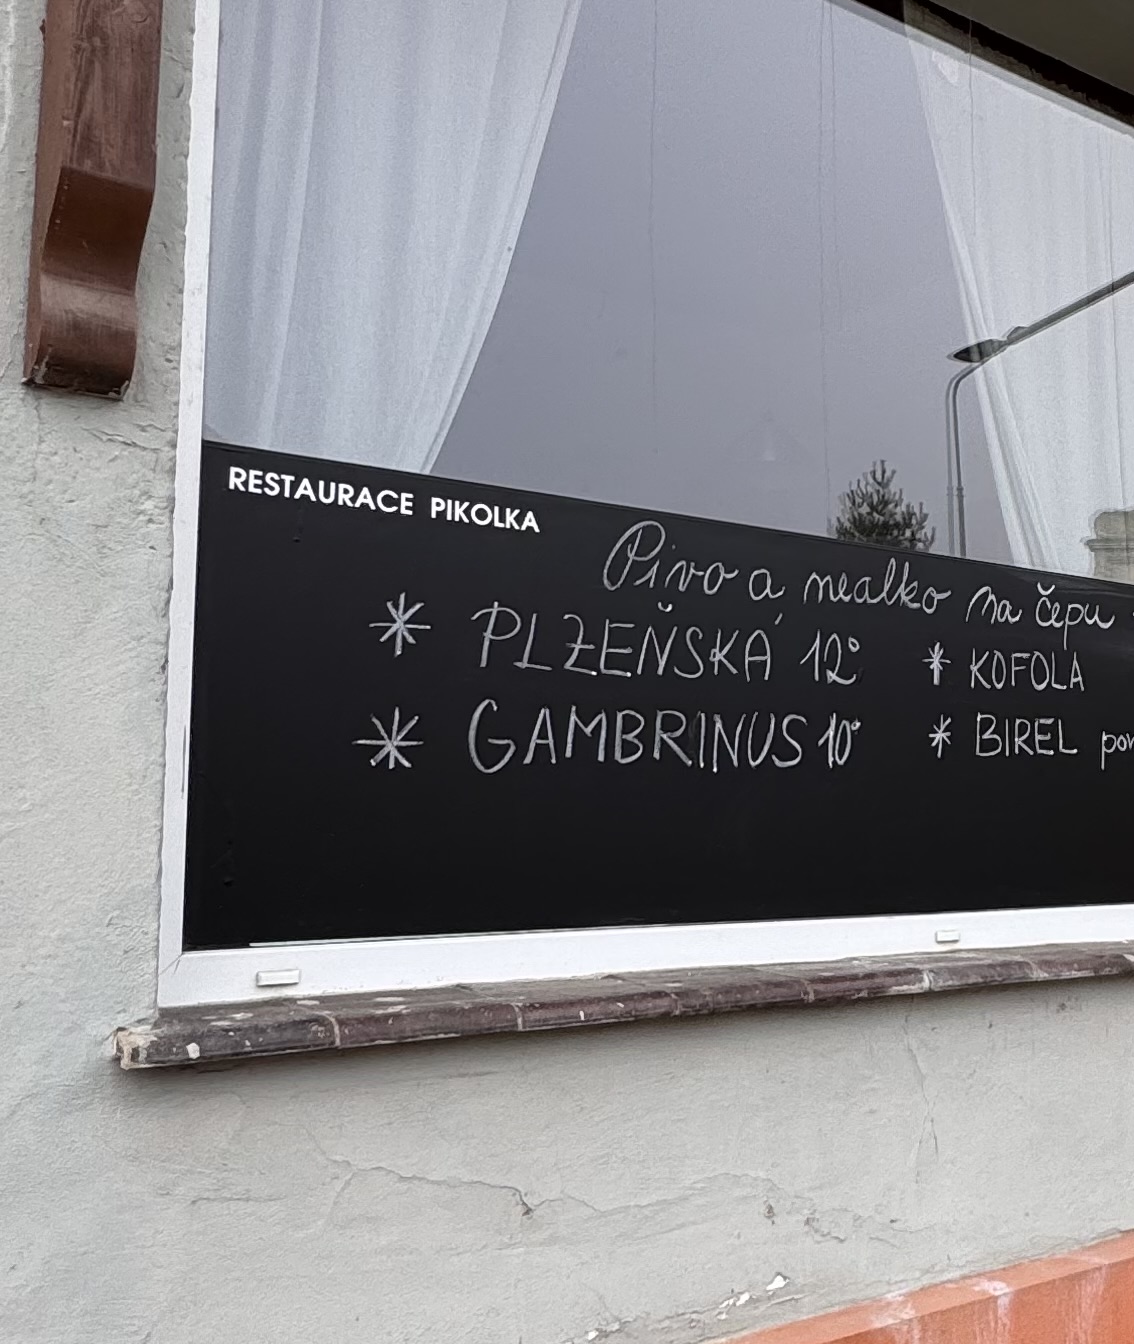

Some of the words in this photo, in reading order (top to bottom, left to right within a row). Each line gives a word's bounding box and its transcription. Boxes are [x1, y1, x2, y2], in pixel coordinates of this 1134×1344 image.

[228, 466, 414, 516] RESTAURACE
[430, 496, 540, 534] PIKOLKA
[603, 520, 740, 595] Pivo
[749, 568, 786, 601] a
[802, 557, 952, 614] nealko
[1035, 581, 1116, 650] čepu
[471, 600, 784, 683] PLZEŇSKÁ
[799, 628, 861, 686] 12°
[970, 647, 1085, 692] KOFOLA
[467, 698, 808, 774] GAMBRINUS
[817, 710, 862, 770] 10°
[975, 711, 1078, 757] BIREL
